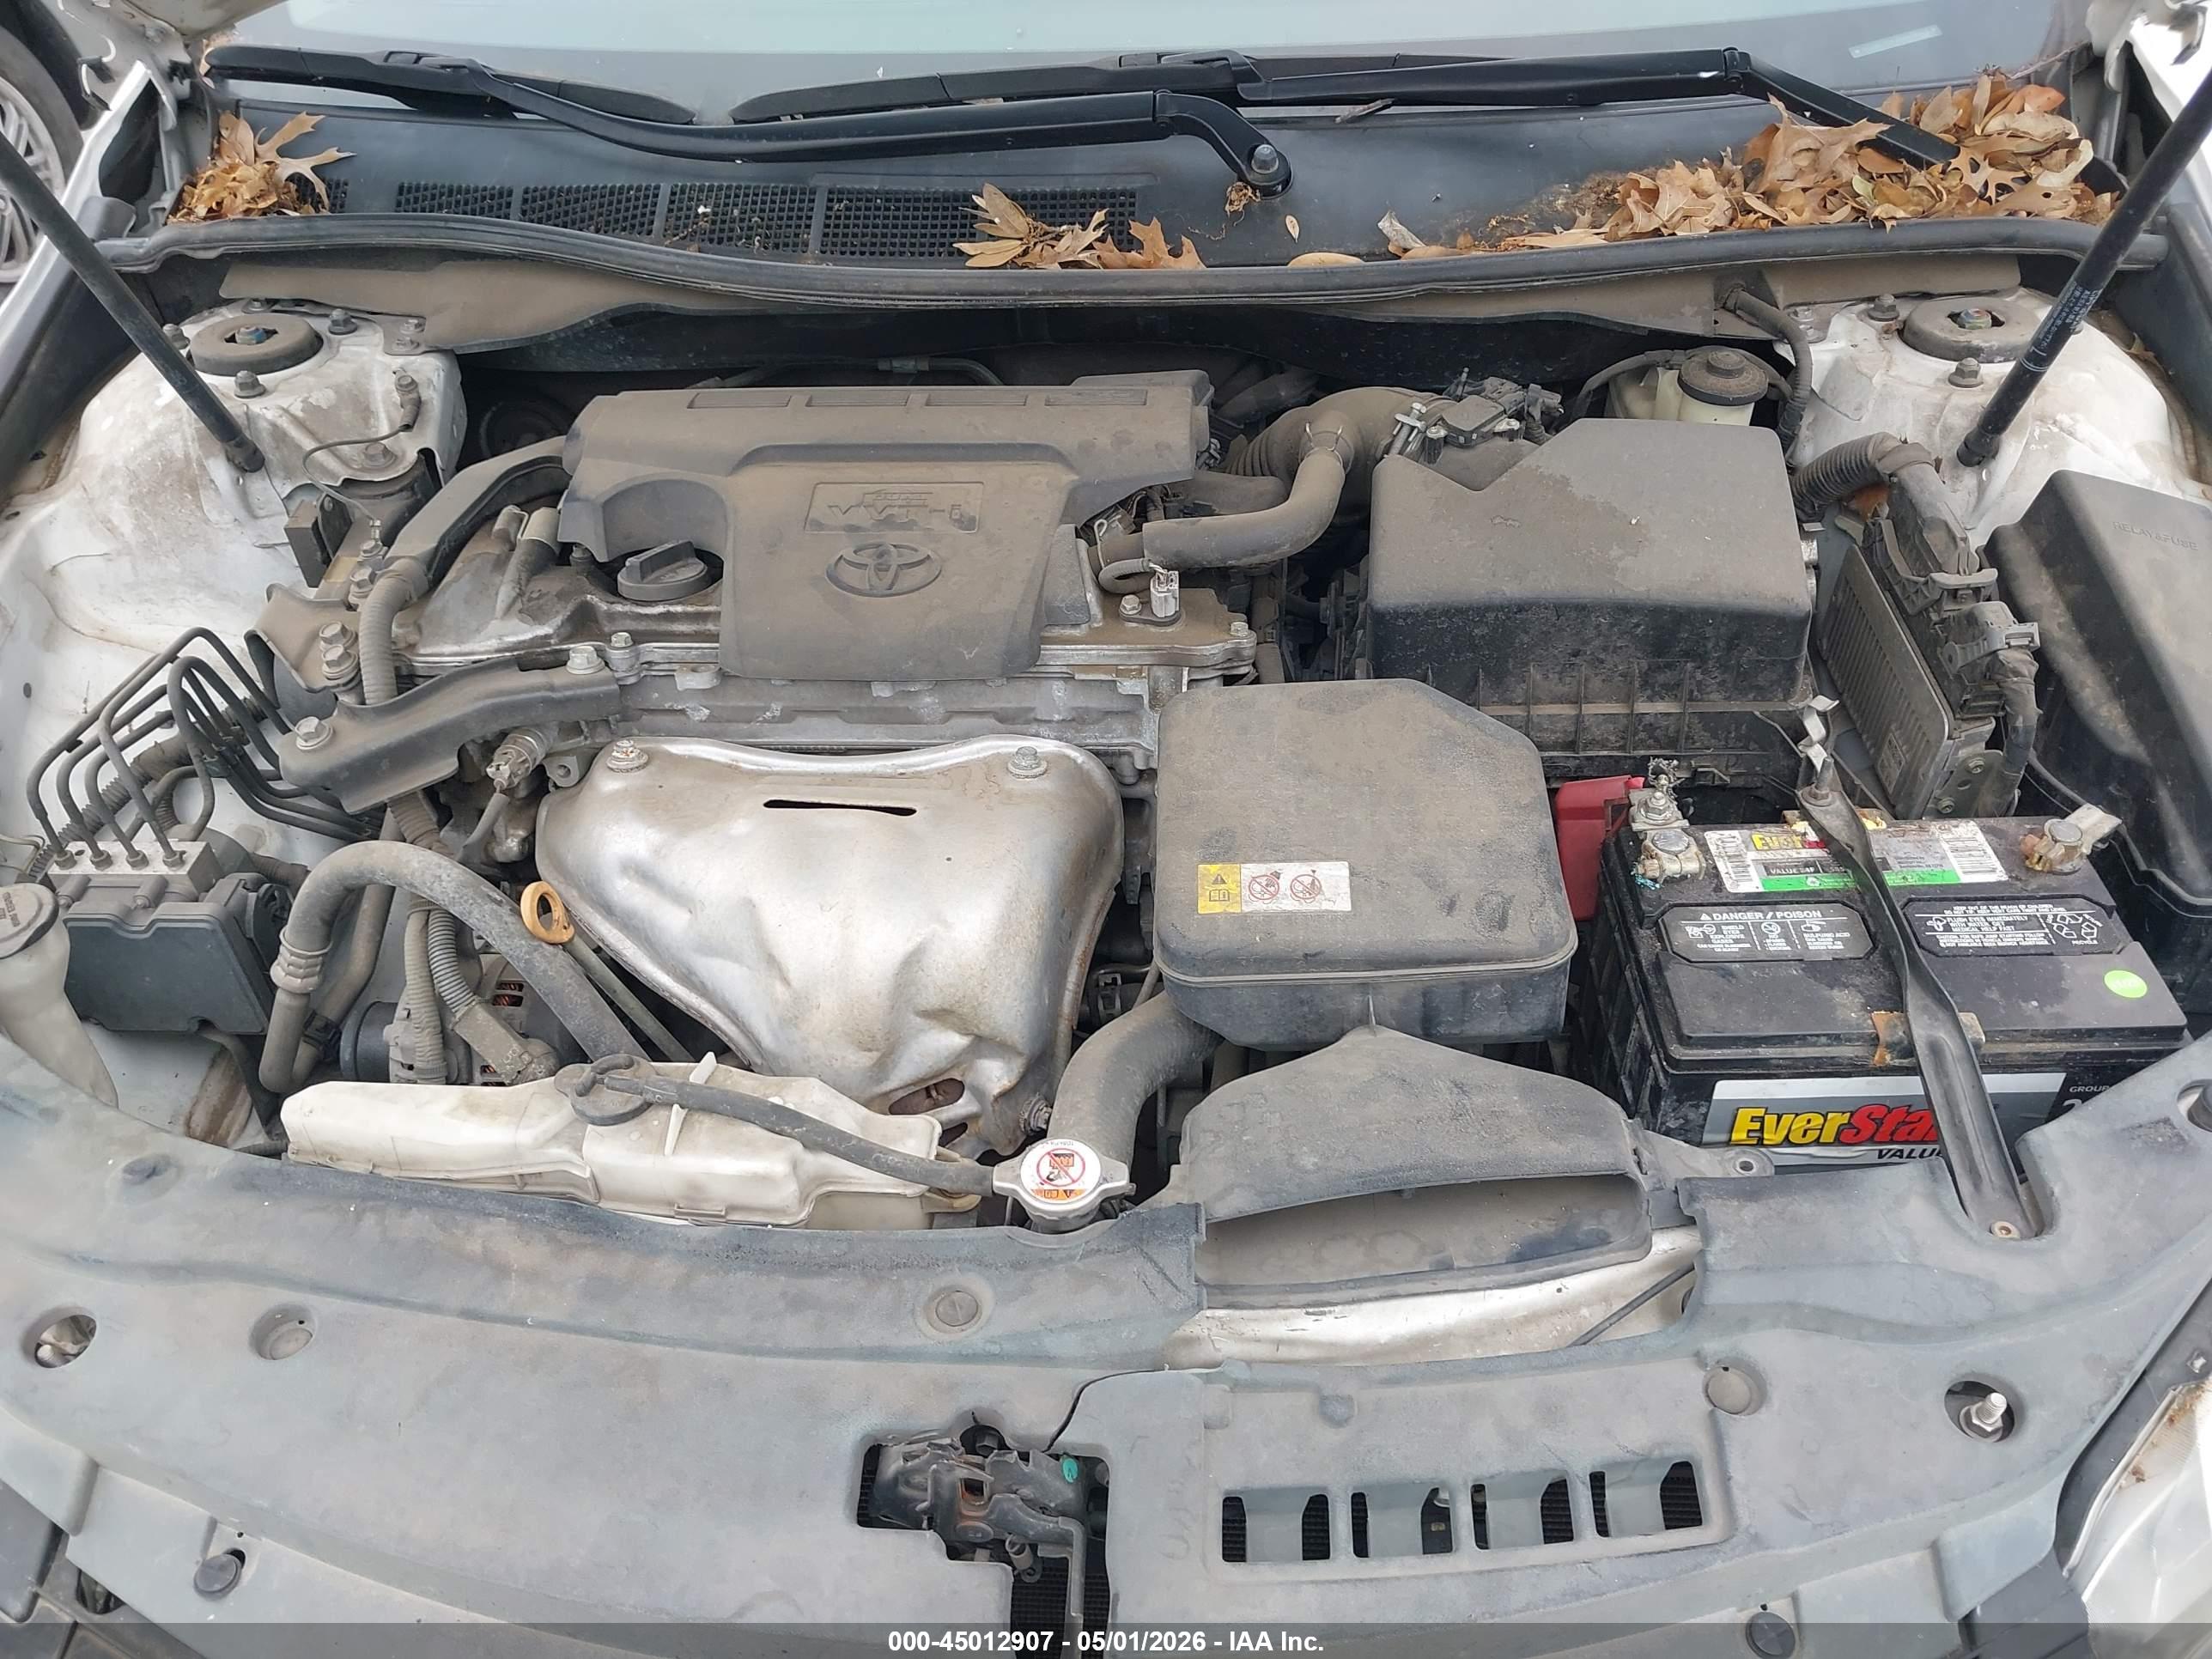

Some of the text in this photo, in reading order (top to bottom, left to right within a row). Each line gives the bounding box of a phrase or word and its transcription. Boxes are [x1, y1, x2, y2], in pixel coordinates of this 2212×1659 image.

[1713, 912, 1765, 921] DANGER
[1776, 910, 1822, 919] POISON
[1729, 1103, 1938, 1145] EverSta
[1876, 1147, 1942, 1160] VALU
